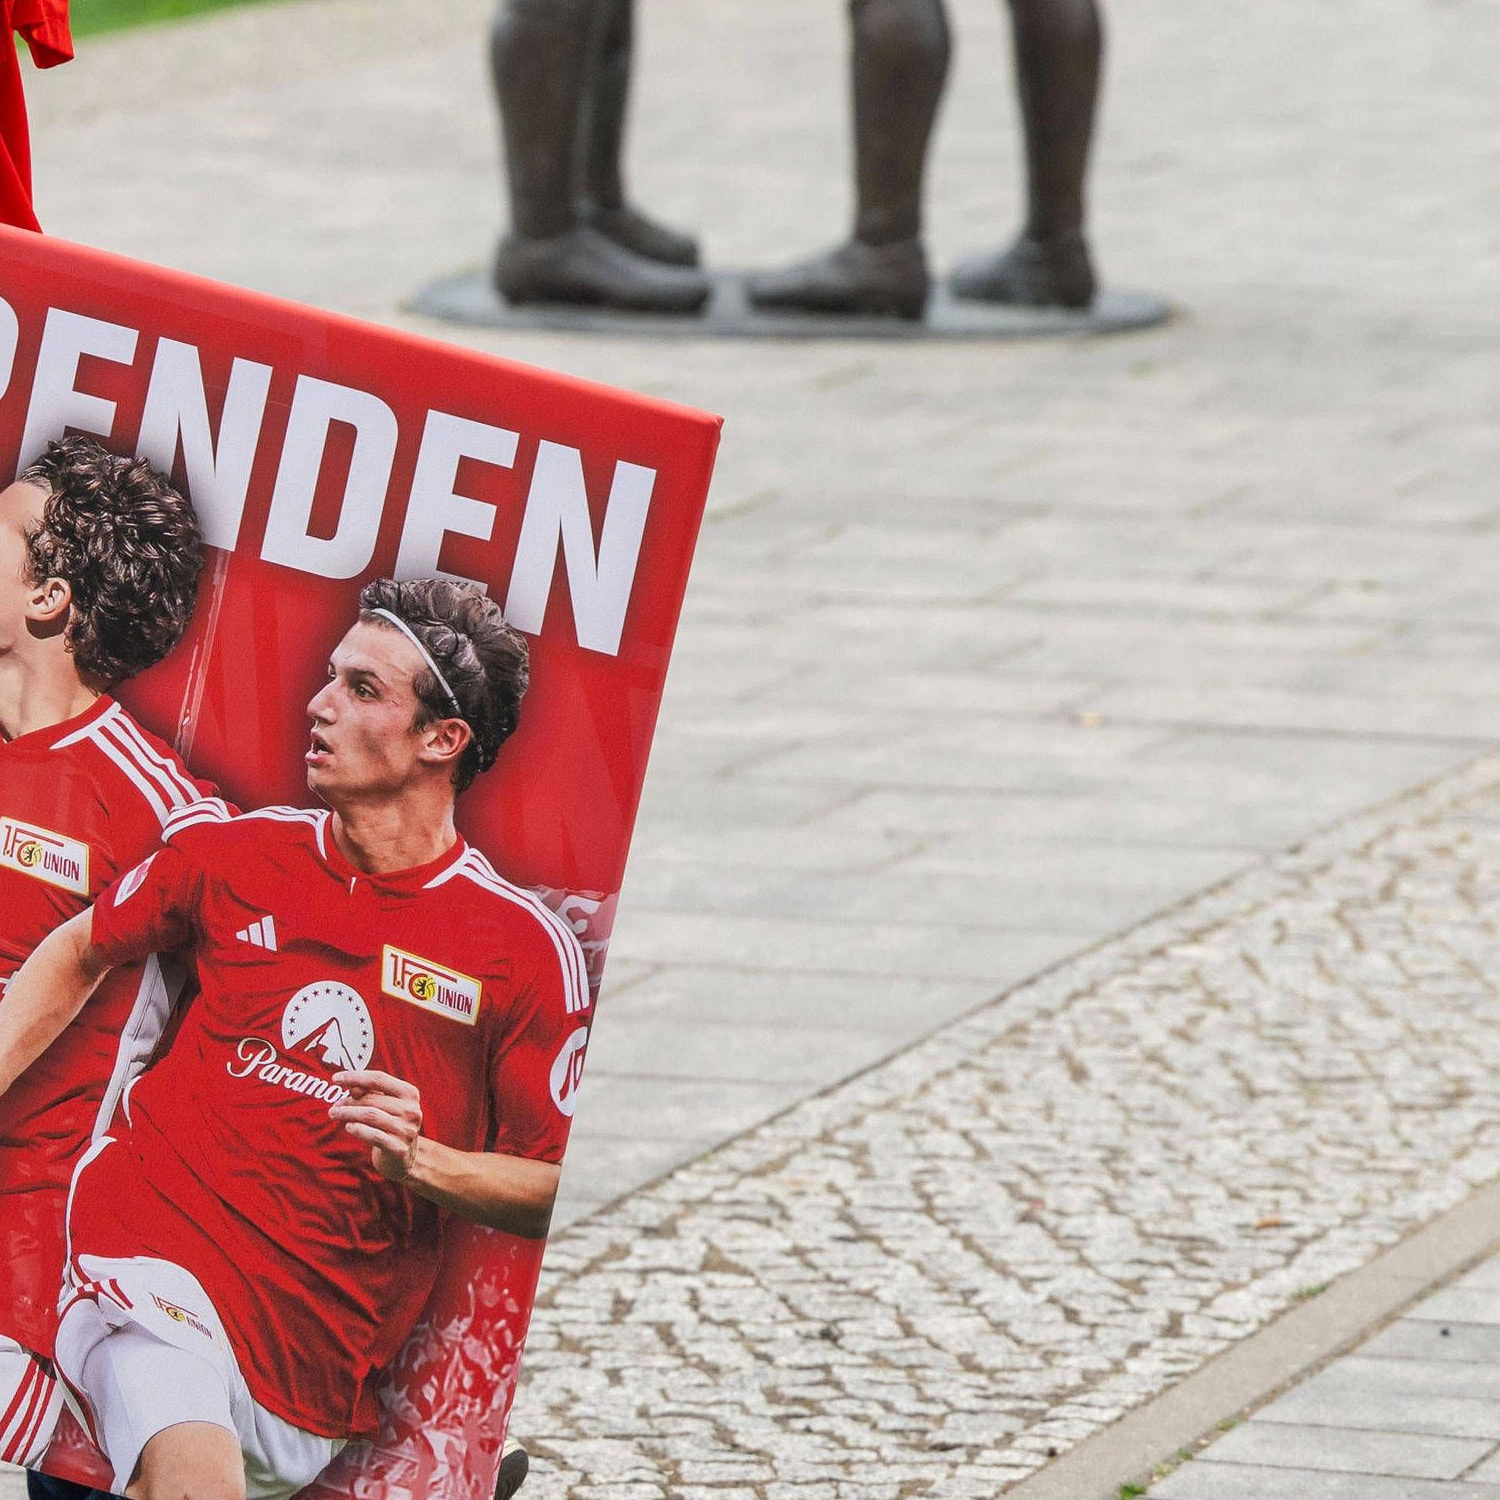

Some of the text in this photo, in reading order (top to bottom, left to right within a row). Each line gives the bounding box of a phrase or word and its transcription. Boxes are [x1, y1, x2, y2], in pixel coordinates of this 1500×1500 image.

[42, 850, 81, 882] UNION
[437, 984, 474, 1015] UNION
[226, 1036, 350, 1104] Paramo
